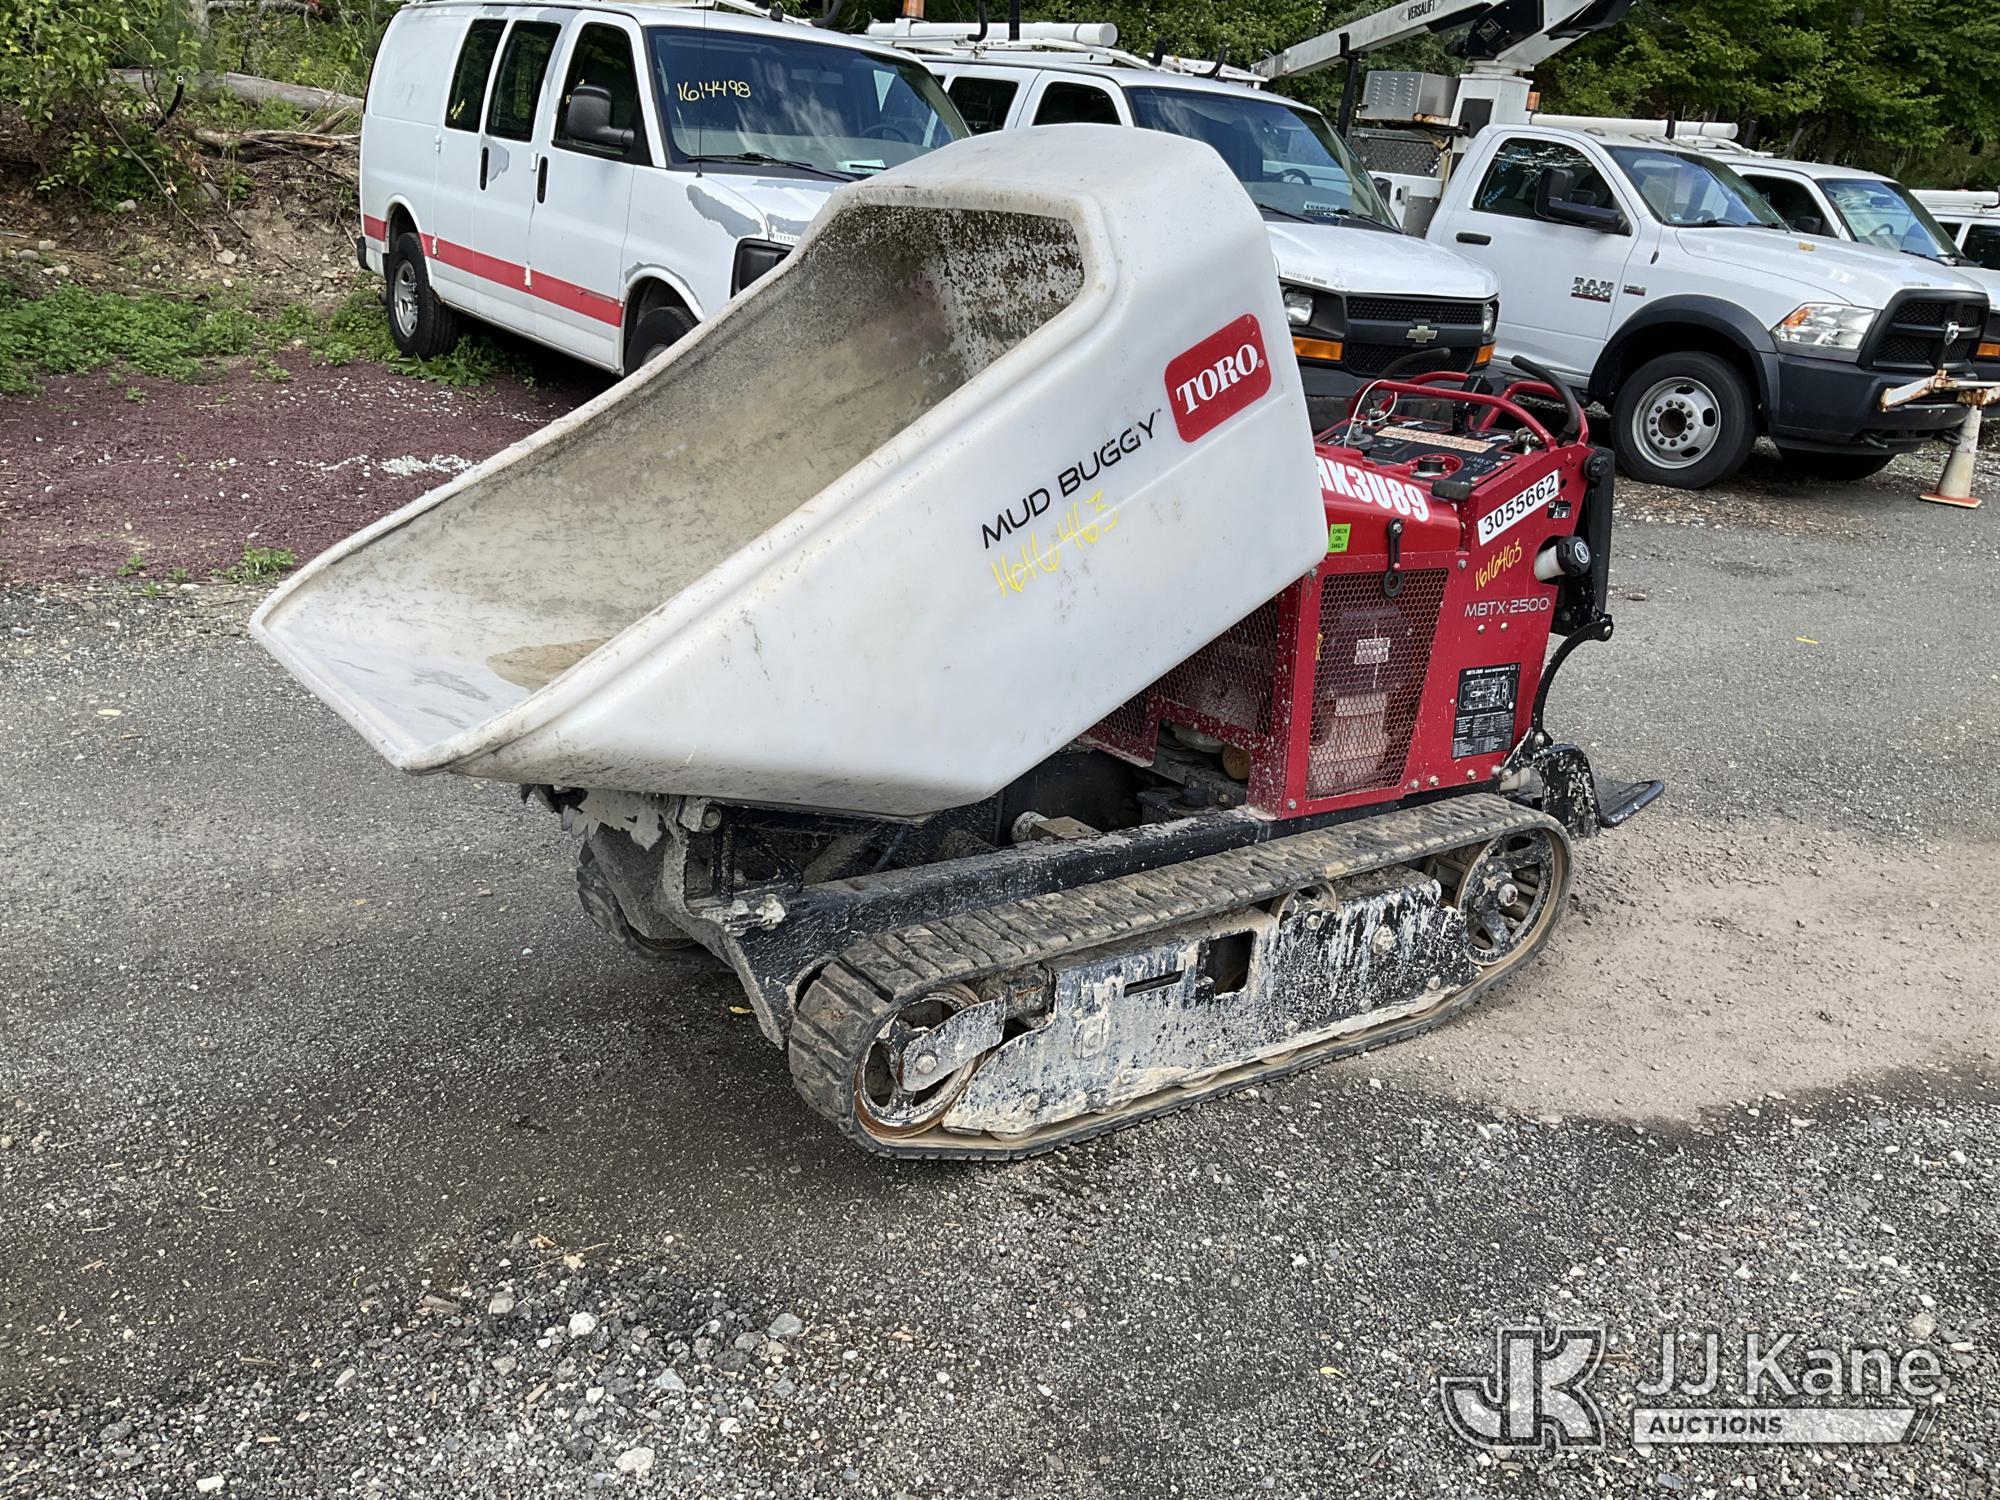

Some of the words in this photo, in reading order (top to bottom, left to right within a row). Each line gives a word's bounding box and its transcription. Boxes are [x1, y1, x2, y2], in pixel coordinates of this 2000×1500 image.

[677, 80, 751, 101] 1614498
[1574, 277, 1614, 290] RAM
[1176, 344, 1259, 415] TORO
[981, 487, 1051, 549] MUD
[1057, 412, 1157, 497] BUGGY
[1483, 474, 1555, 535] 3055662
[991, 489, 1120, 598] 1616463
[1475, 537, 1522, 591] 1616463
